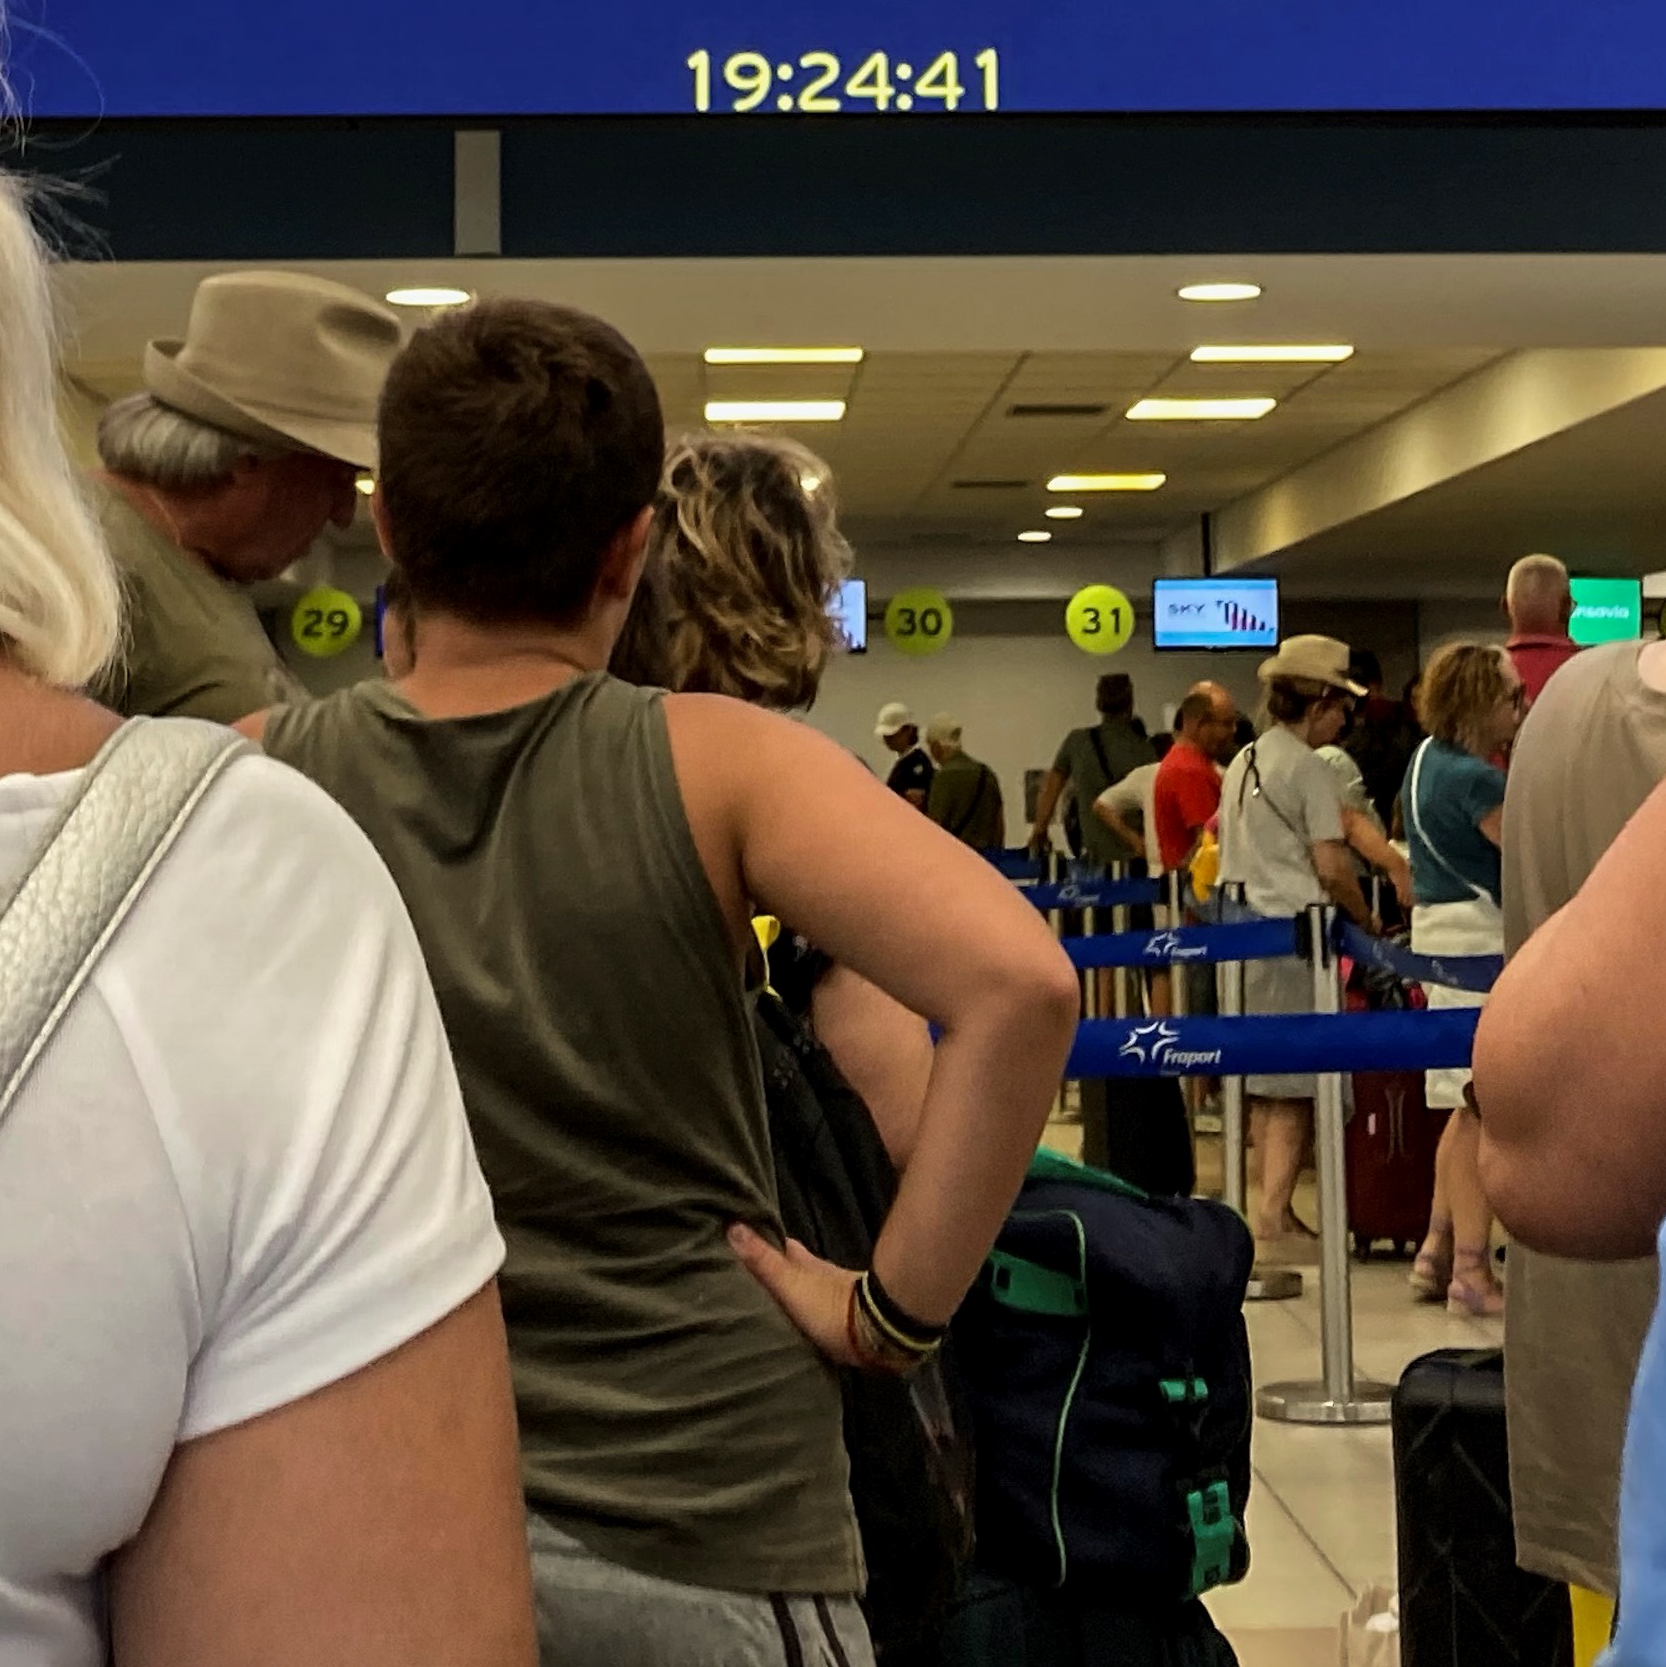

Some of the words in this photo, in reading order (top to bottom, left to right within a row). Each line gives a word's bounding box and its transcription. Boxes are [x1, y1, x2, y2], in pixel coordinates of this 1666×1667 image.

[686, 48, 1000, 112] 19:24:41
[301, 608, 351, 638] 29
[895, 606, 945, 637] 30
[1081, 606, 1121, 636] 31
